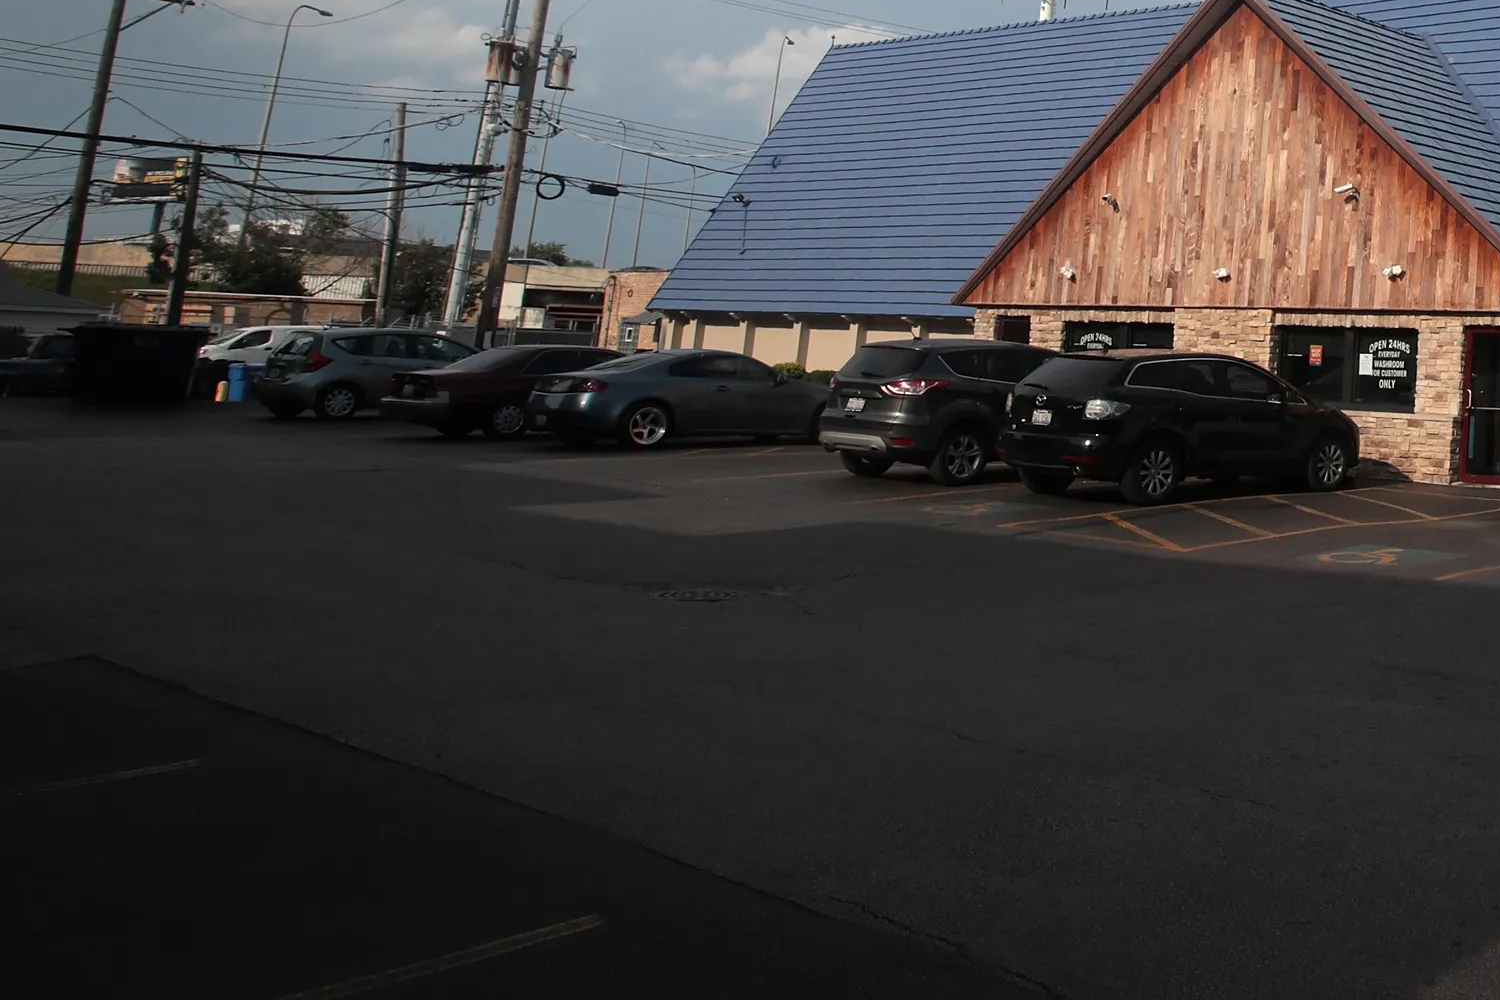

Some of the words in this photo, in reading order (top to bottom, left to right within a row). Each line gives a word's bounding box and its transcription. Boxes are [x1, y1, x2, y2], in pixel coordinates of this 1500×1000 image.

[1080, 333, 1095, 345] OPEN
[1095, 333, 1112, 346] 24HRS
[1369, 340, 1387, 353] OPEN
[1388, 339, 1411, 354] 24HRS
[1374, 360, 1405, 368] WASHROOM
[1379, 379, 1396, 389] ONLY
